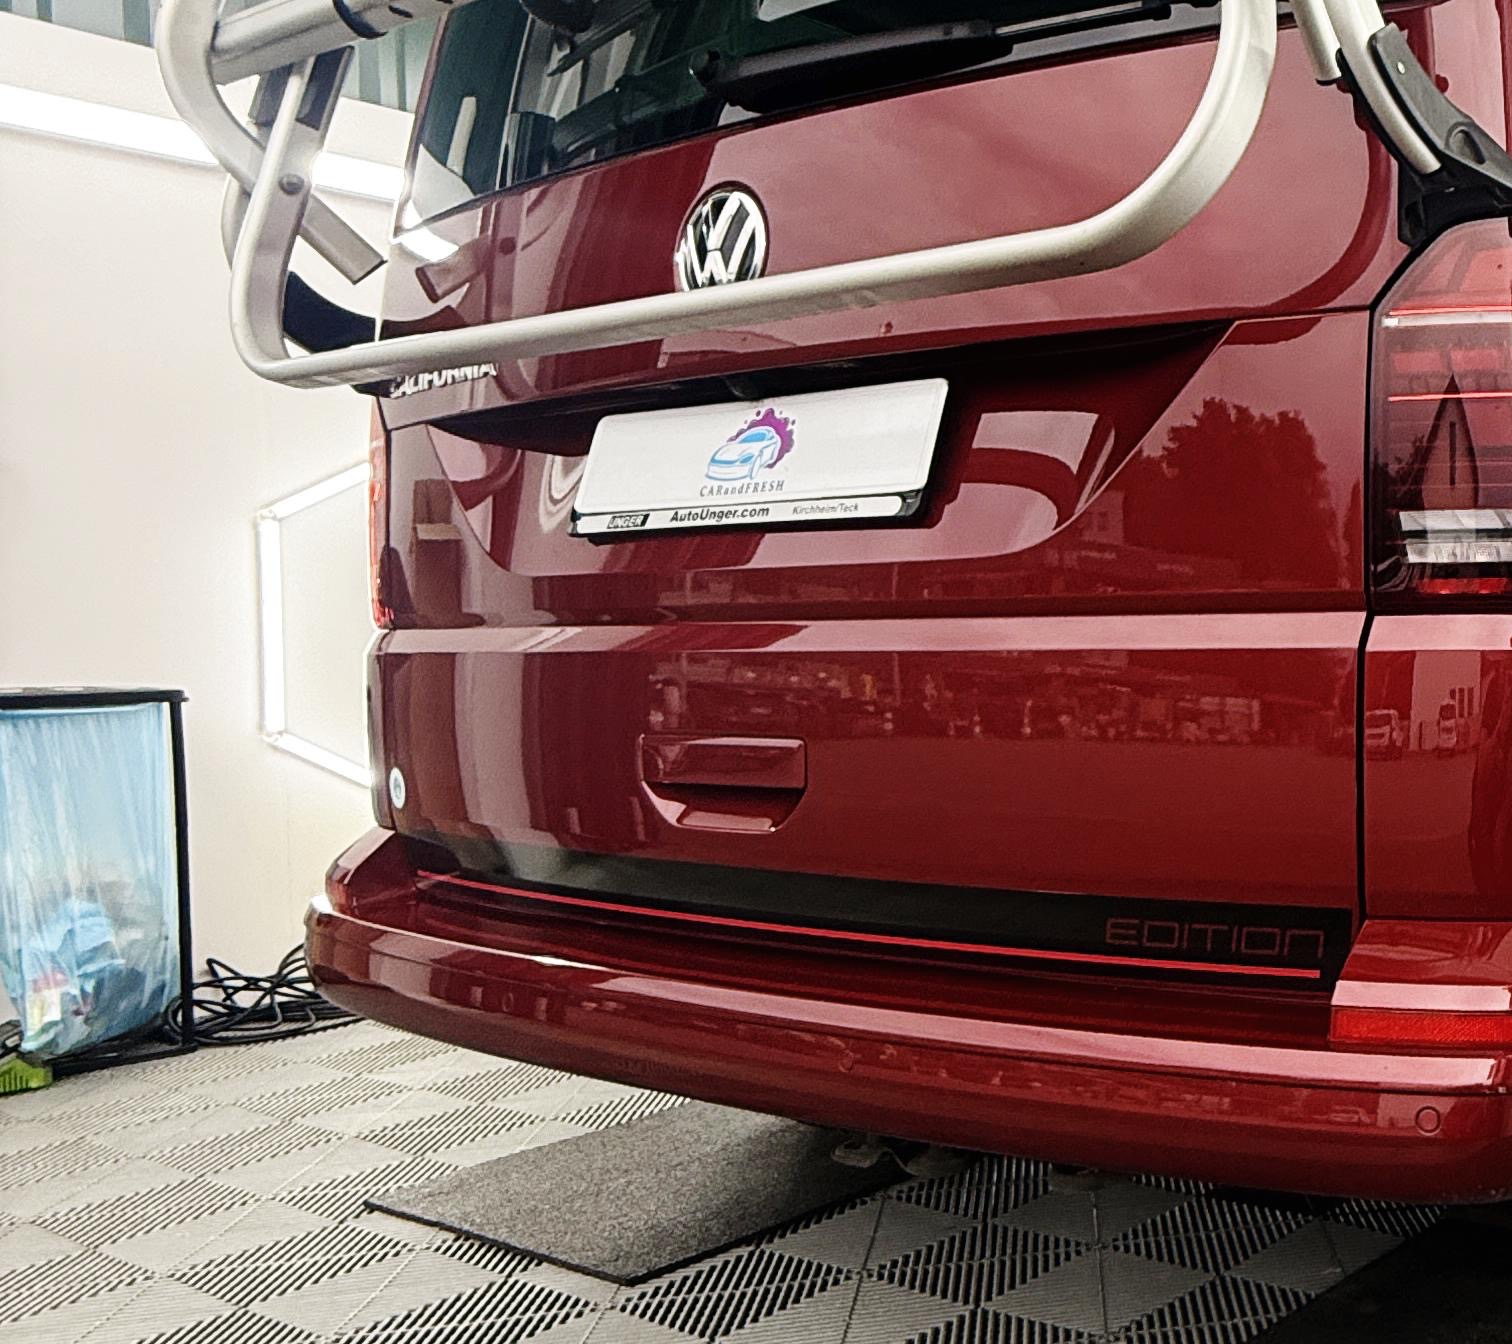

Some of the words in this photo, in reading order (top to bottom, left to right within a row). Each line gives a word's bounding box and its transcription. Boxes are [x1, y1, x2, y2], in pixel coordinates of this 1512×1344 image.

[607, 514, 645, 529] UNGER
[670, 506, 770, 524] AutoUnger.com
[1105, 917, 1325, 959] EDITION
